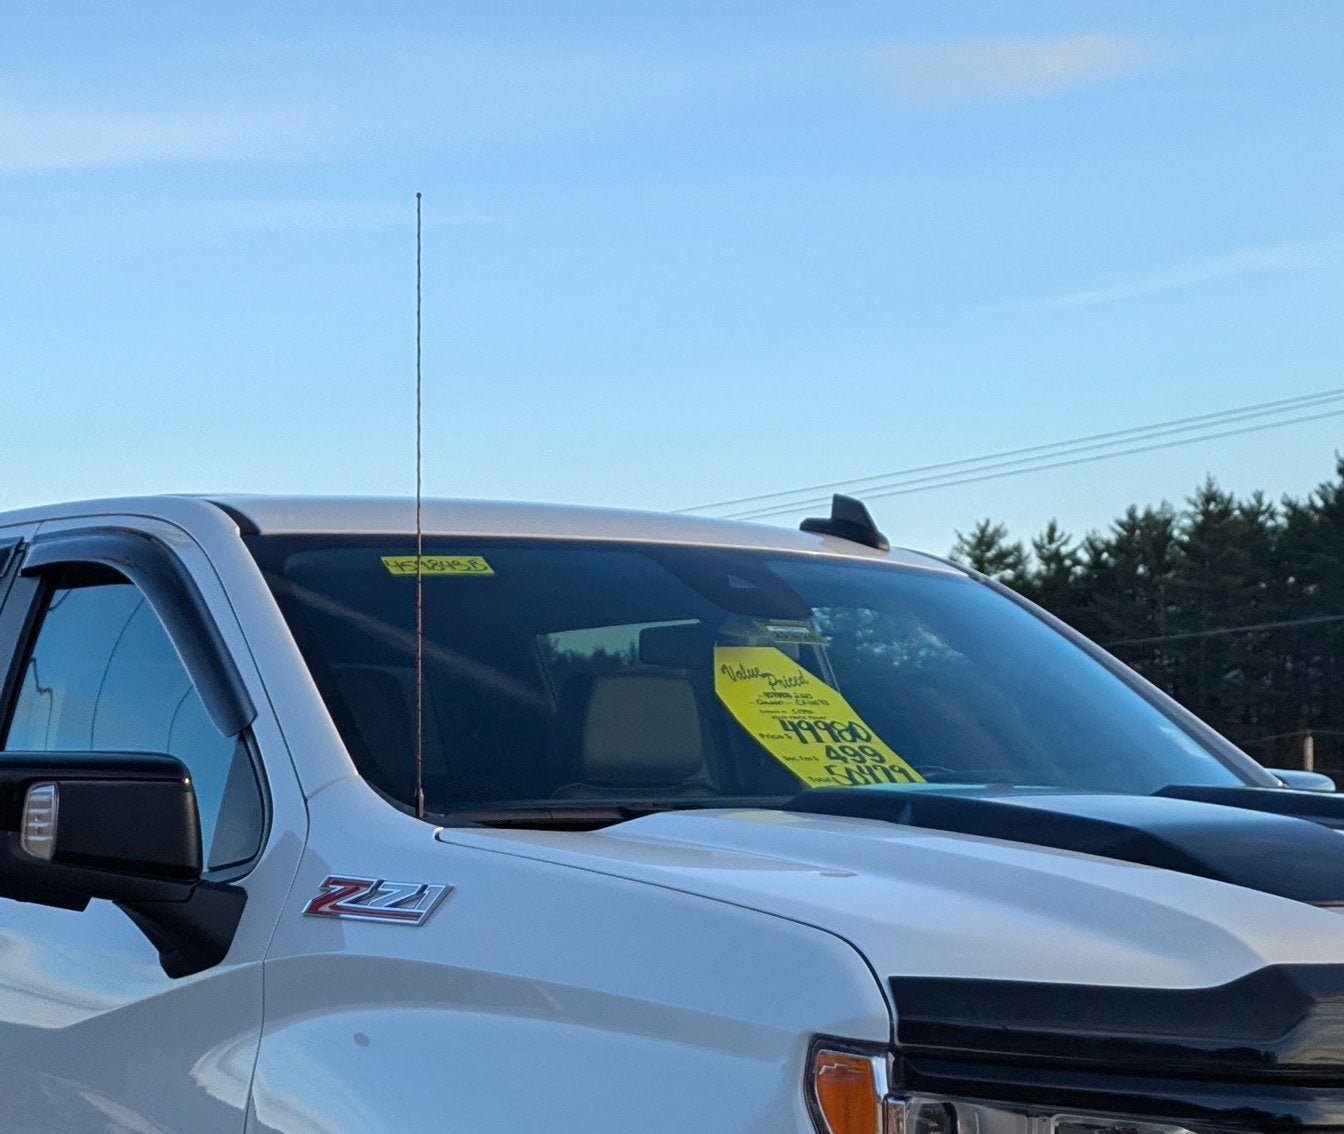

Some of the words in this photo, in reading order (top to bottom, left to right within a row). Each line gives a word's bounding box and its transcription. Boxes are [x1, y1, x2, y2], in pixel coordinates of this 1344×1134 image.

[721, 663, 760, 682] Value
[760, 669, 809, 691] Priced
[779, 719, 872, 744] 49980
[825, 745, 886, 764] 499
[824, 764, 917, 786] 50479
[301, 874, 455, 927] Z71
